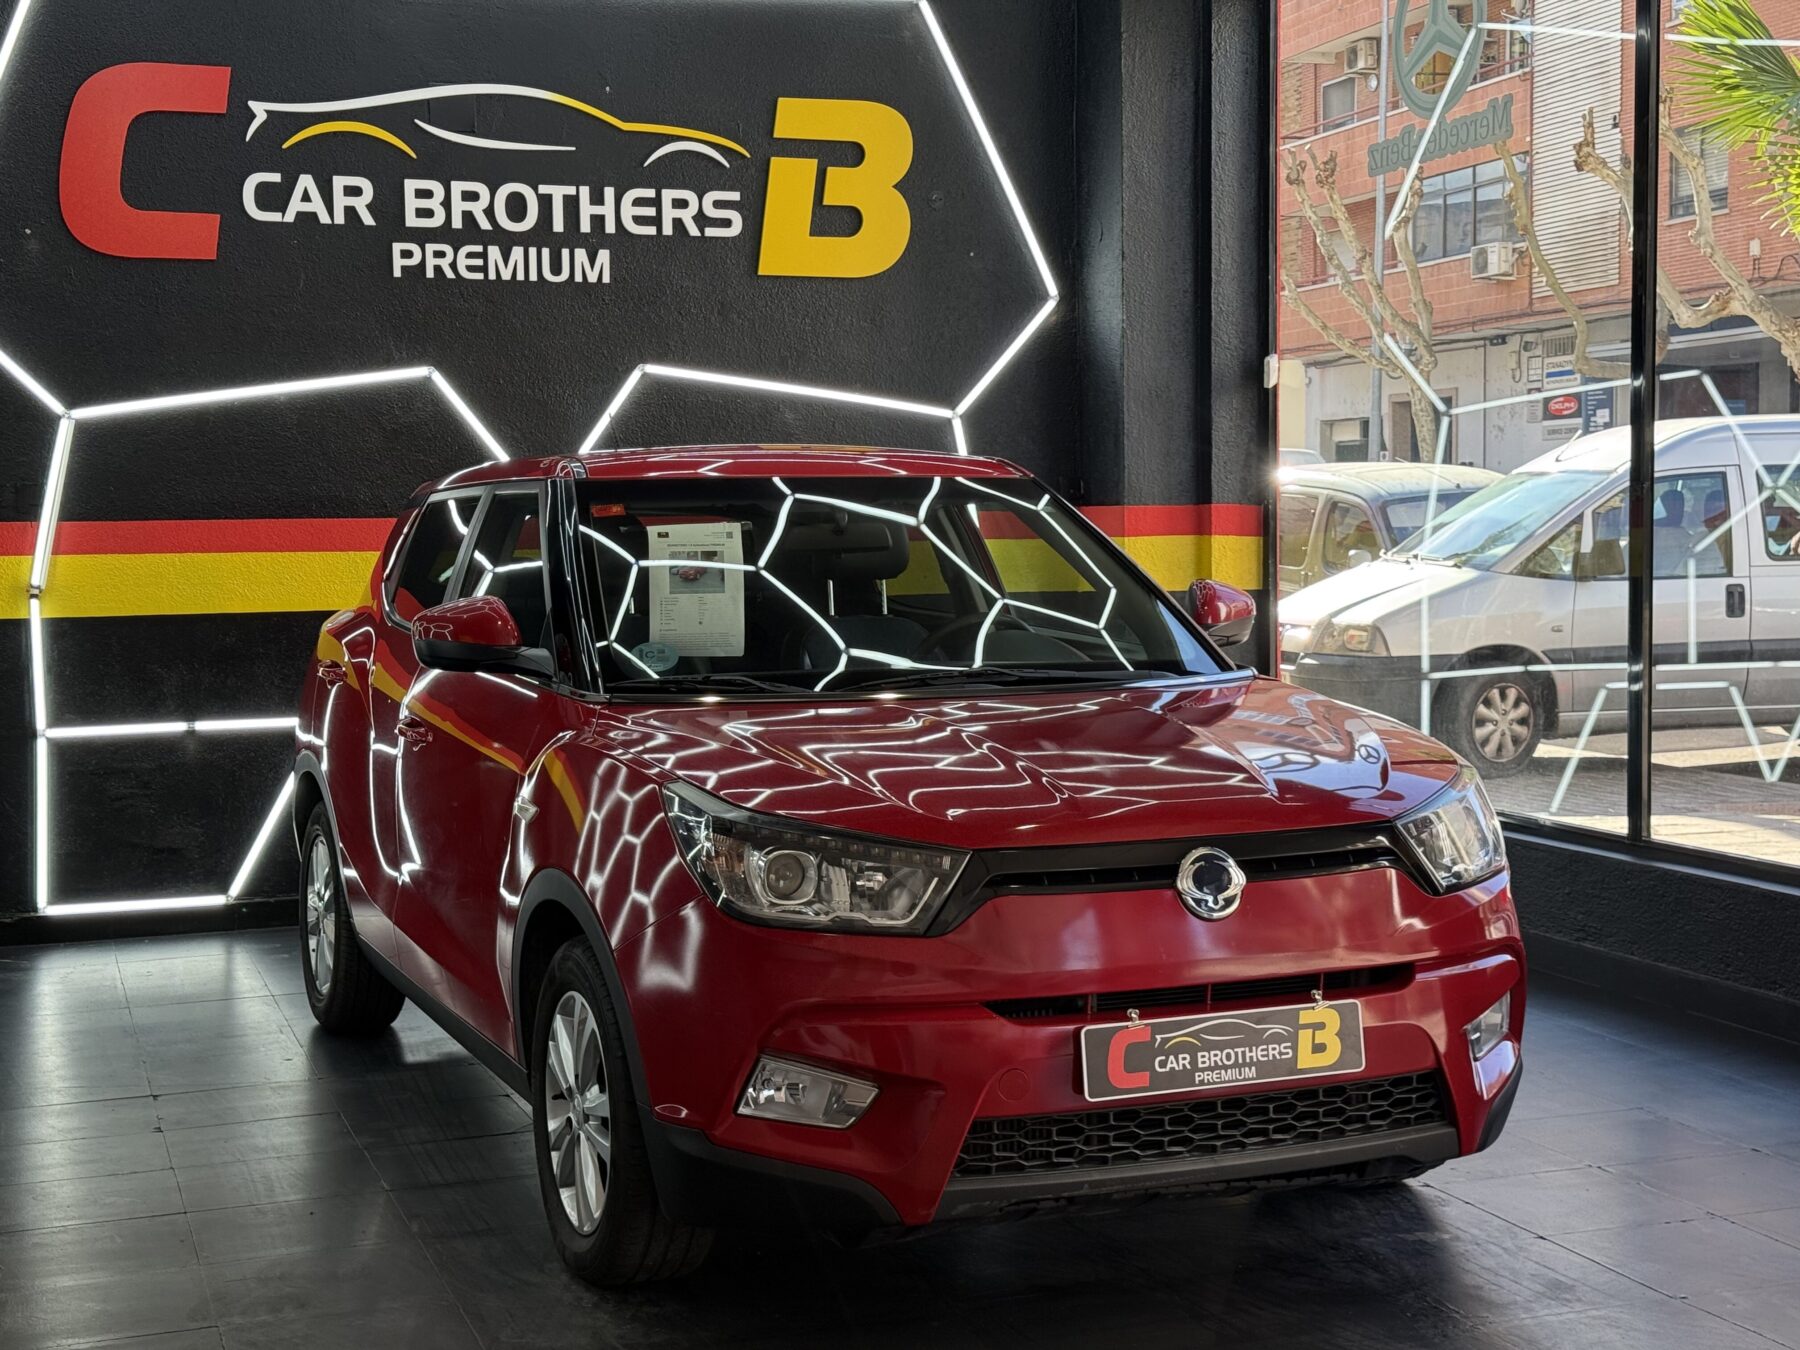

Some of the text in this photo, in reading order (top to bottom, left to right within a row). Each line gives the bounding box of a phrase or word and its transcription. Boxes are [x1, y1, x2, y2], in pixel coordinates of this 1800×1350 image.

[60, 62, 231, 259] C
[758, 97, 913, 277] B
[243, 172, 743, 238] CAR BROTHERS
[392, 243, 610, 284] PREMIUM
[1108, 1025, 1151, 1089] C
[1154, 1042, 1293, 1073] CAR BROTHERS
[1297, 1007, 1341, 1069] B
[1194, 1066, 1257, 1085] PREMIUM
